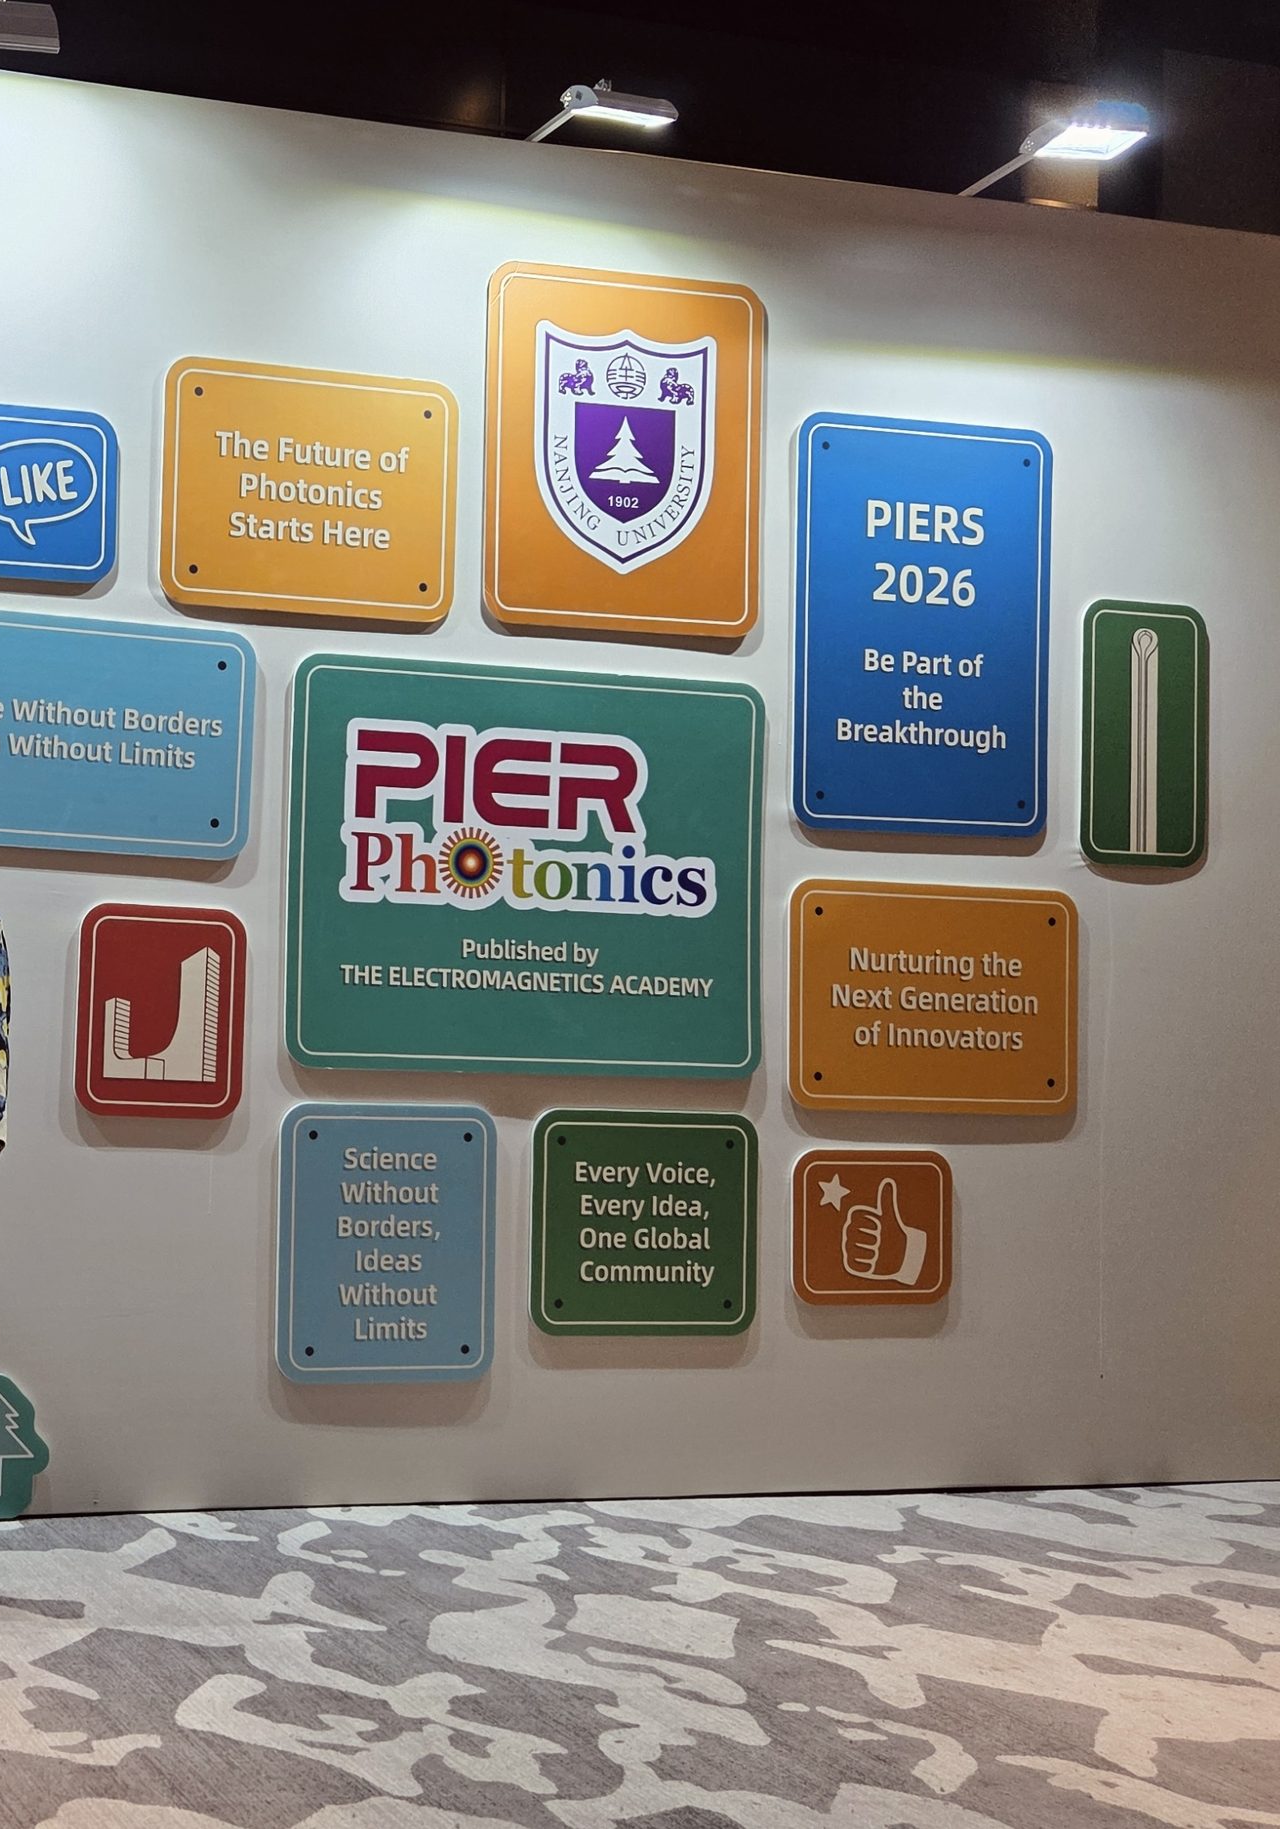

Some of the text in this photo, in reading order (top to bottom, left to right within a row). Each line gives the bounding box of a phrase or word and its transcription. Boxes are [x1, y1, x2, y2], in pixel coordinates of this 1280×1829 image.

[216, 430, 410, 473] The Future of
[0, 460, 78, 507] LIKE
[240, 472, 383, 510] Photonics
[553, 434, 695, 546] NANJING UNIVERSITY
[608, 495, 639, 509] 1902
[229, 512, 391, 549] Starts Here
[866, 499, 985, 545] PIERS
[872, 562, 976, 607] 2026
[864, 648, 984, 678] Be Part of
[902, 685, 943, 711] the
[13, 698, 116, 729] Without
[123, 708, 223, 737] Borders
[9, 732, 113, 763] Without
[120, 742, 196, 769] Limits
[837, 719, 1007, 754] Breakthrough
[355, 729, 638, 833] PIER
[350, 827, 707, 907] Photonics
[462, 938, 599, 967] Published by
[849, 947, 1022, 980] Nurturing the
[341, 964, 714, 997] THE ELECTROMAGNETICS ACADEMY
[831, 983, 1039, 1014] Next Generation
[854, 1020, 1023, 1050] of Innovators
[343, 1146, 438, 1171] Science
[575, 1161, 716, 1188] Every Voice,
[341, 1181, 440, 1204] Without
[580, 1194, 710, 1221] Every Idea,
[337, 1214, 441, 1241] Borders,
[579, 1226, 711, 1251] One Global
[356, 1248, 422, 1272] Ideas
[579, 1260, 715, 1288] Community
[339, 1283, 438, 1306] Without
[354, 1316, 428, 1341] Limits
